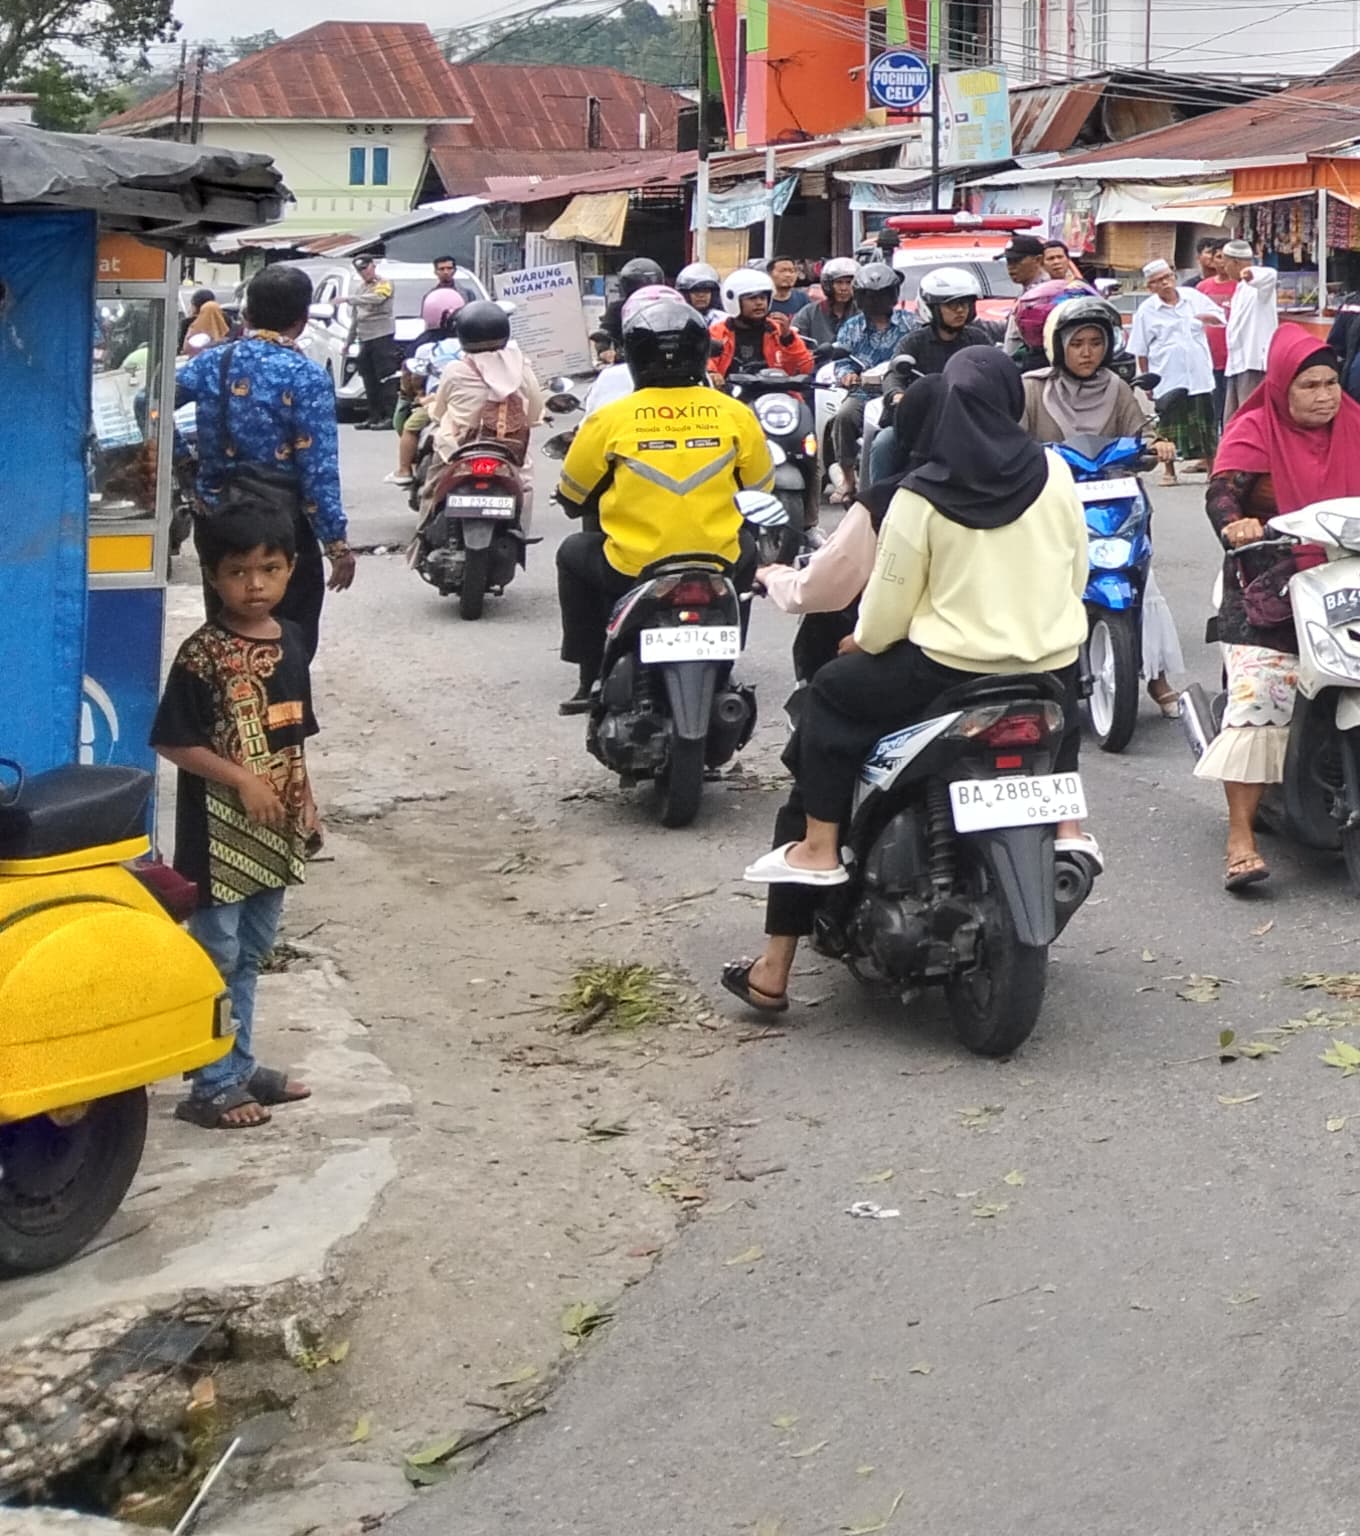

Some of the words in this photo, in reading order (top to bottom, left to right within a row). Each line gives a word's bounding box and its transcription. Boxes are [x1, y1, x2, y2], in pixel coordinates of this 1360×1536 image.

[873, 72, 928, 85] POCHINKI
[885, 86, 914, 100] CELL
[511, 268, 562, 284] WARUNG
[503, 277, 573, 296] NUSANTARA
[635, 402, 718, 420] maxim
[1326, 593, 1347, 610] BA
[958, 785, 985, 805] BA
[993, 780, 1043, 801] 2886
